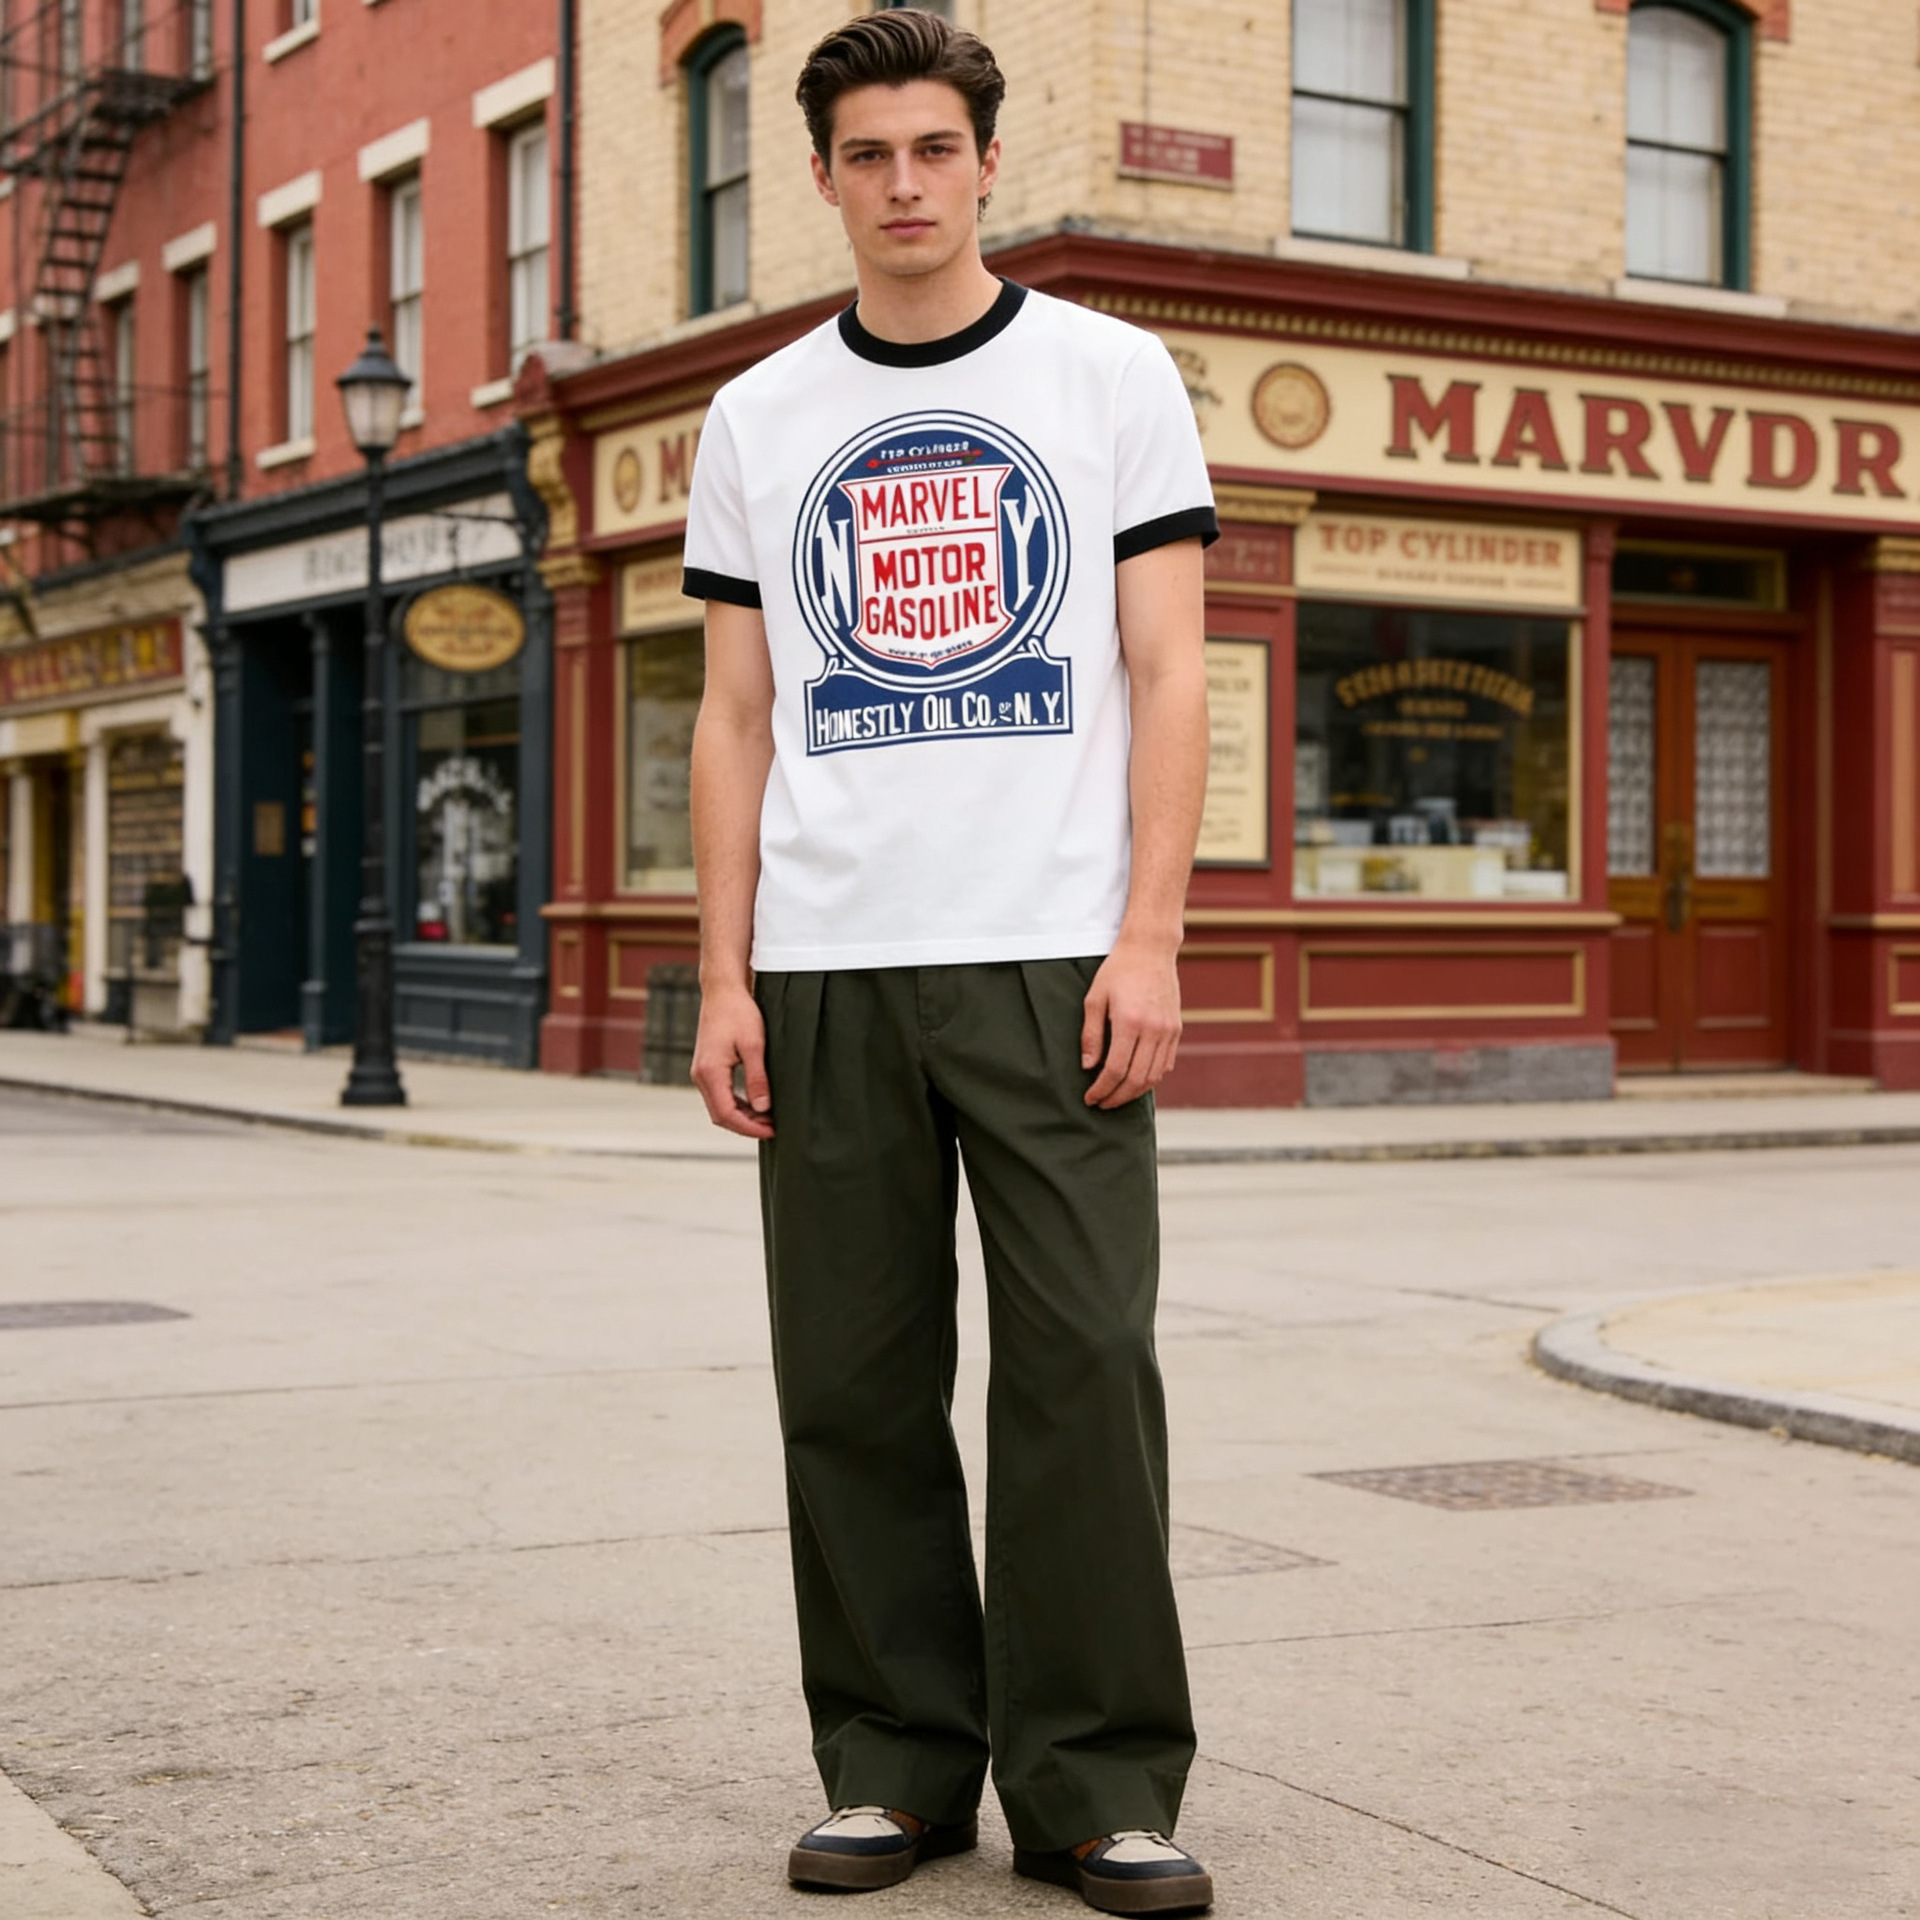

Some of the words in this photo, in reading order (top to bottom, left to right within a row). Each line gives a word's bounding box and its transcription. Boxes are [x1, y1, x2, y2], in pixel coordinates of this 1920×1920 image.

[861, 476, 991, 530] MARVEL
[815, 504, 852, 629] N
[1001, 484, 1041, 611] Y
[872, 542, 986, 593] MOTOR
[1318, 523, 1388, 556] TOP
[1400, 531, 1562, 567] CYLINDER
[864, 585, 998, 641] GASOLINE
[815, 701, 914, 746] HONESTLY
[922, 694, 958, 731] OIL
